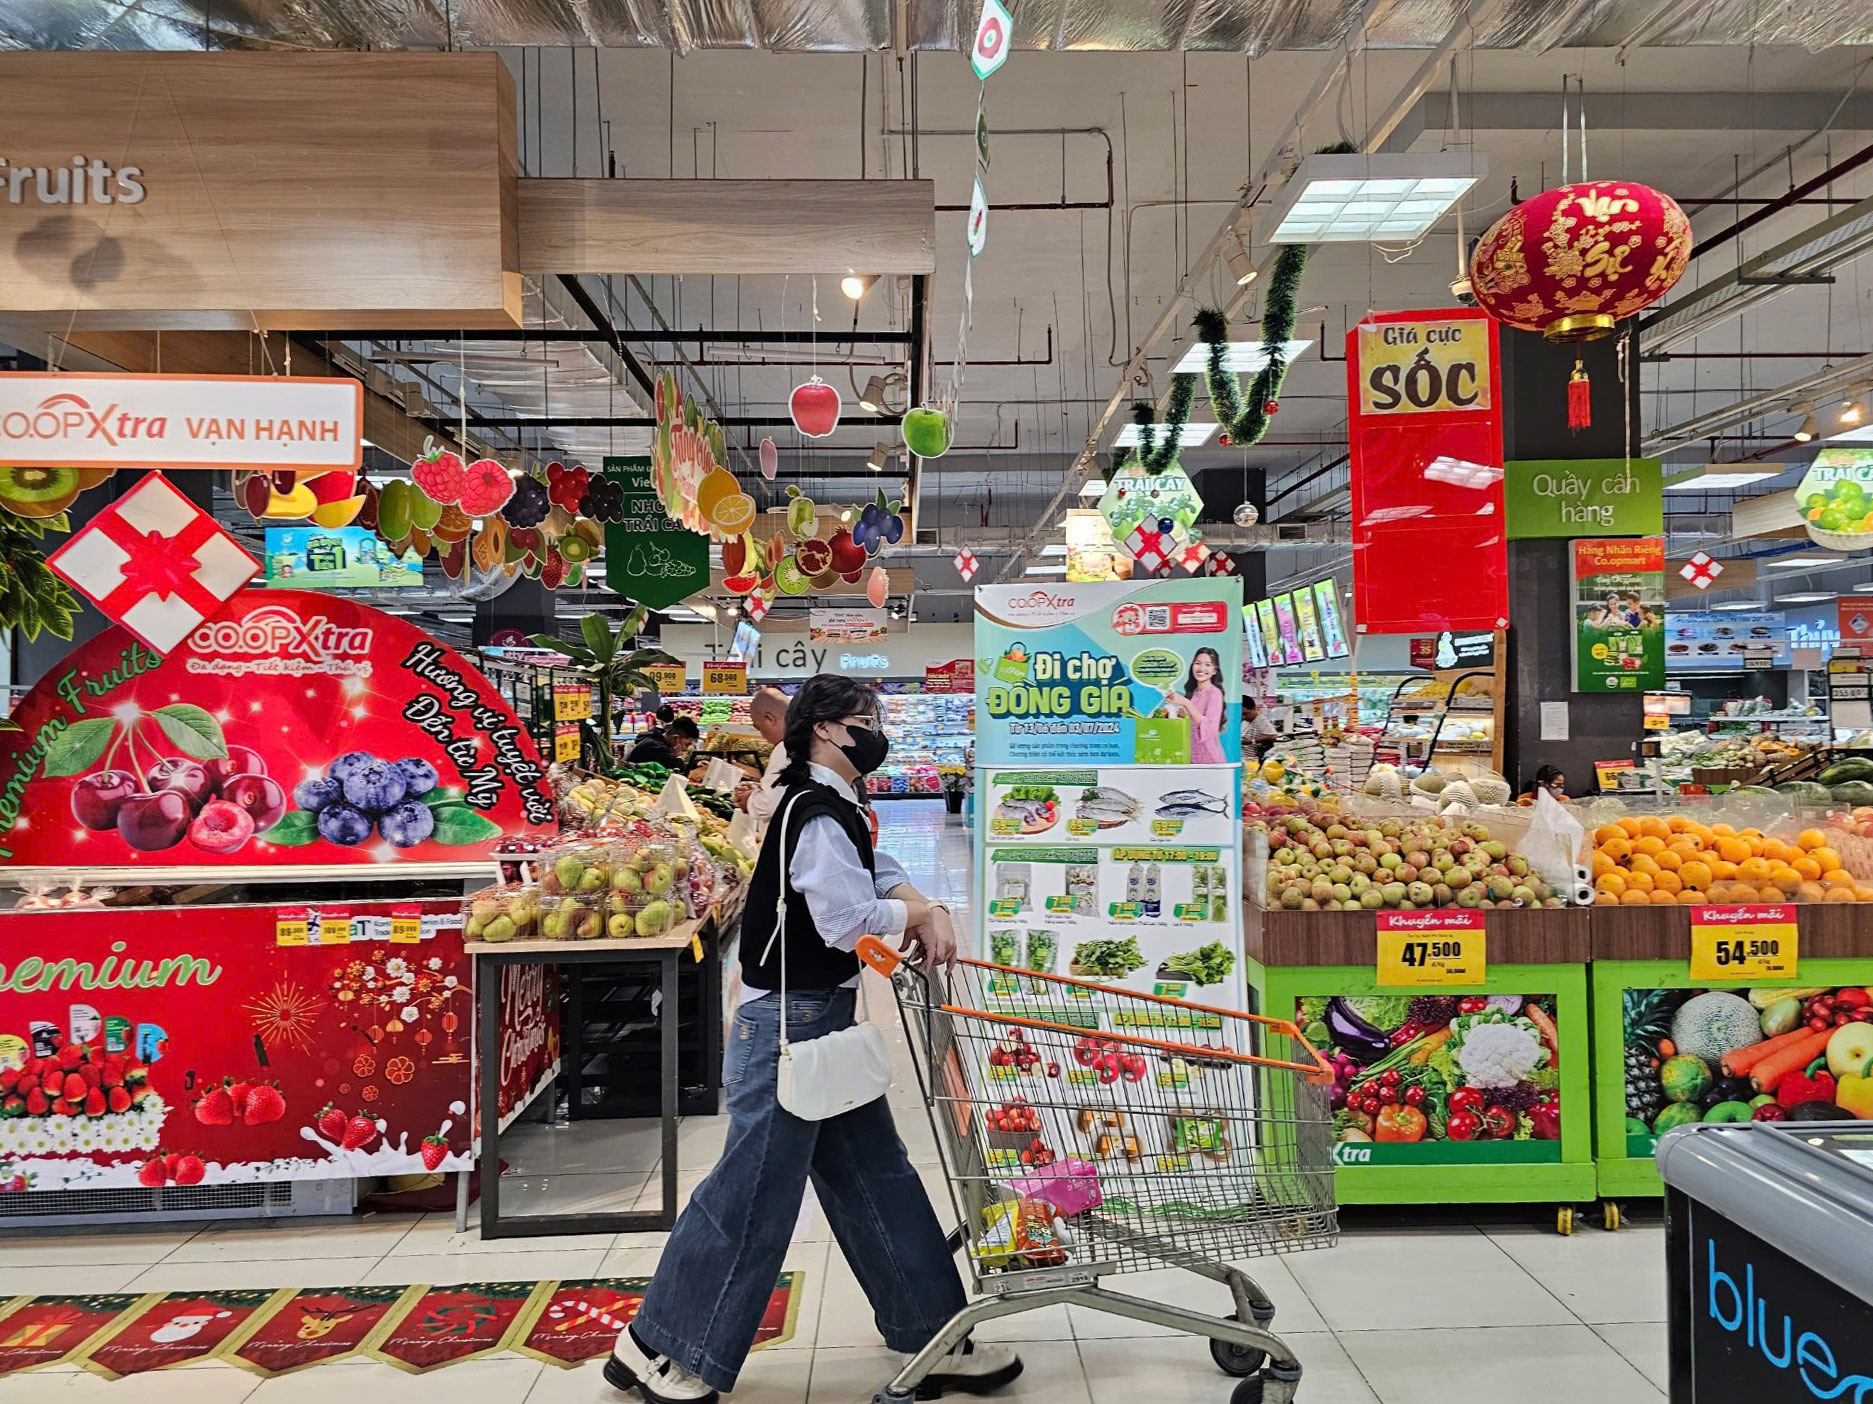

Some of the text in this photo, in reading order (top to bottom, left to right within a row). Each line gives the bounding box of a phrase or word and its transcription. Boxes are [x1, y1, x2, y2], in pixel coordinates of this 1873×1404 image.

[1383, 326, 1462, 346] Giá cực
[1369, 347, 1479, 410] SỐC
[0, 403, 339, 448] O.OPXtra VẠN HẠNH
[1532, 469, 1640, 501] Quầy cân
[1561, 500, 1614, 527] hàng
[1579, 546, 1604, 556] Hàng
[1594, 556, 1647, 567] Co.opmart
[776, 640, 828, 673] cây
[839, 652, 890, 670] Fruits
[1034, 651, 1060, 681] Đi
[1066, 651, 1117, 685] chợ
[57, 640, 163, 715] Fruits
[985, 680, 1071, 715] ĐỒNG
[1081, 676, 1131, 714] GIÁ
[402, 642, 554, 825] Hương vị tuyệt vời
[402, 694, 456, 744] Đến
[459, 763, 504, 809] Mỹ
[1389, 912, 1473, 929] Khuyến mãi
[1703, 907, 1785, 923] Khuyến mãi
[1401, 941, 1461, 967] 47.500
[1716, 940, 1779, 966] 54.500
